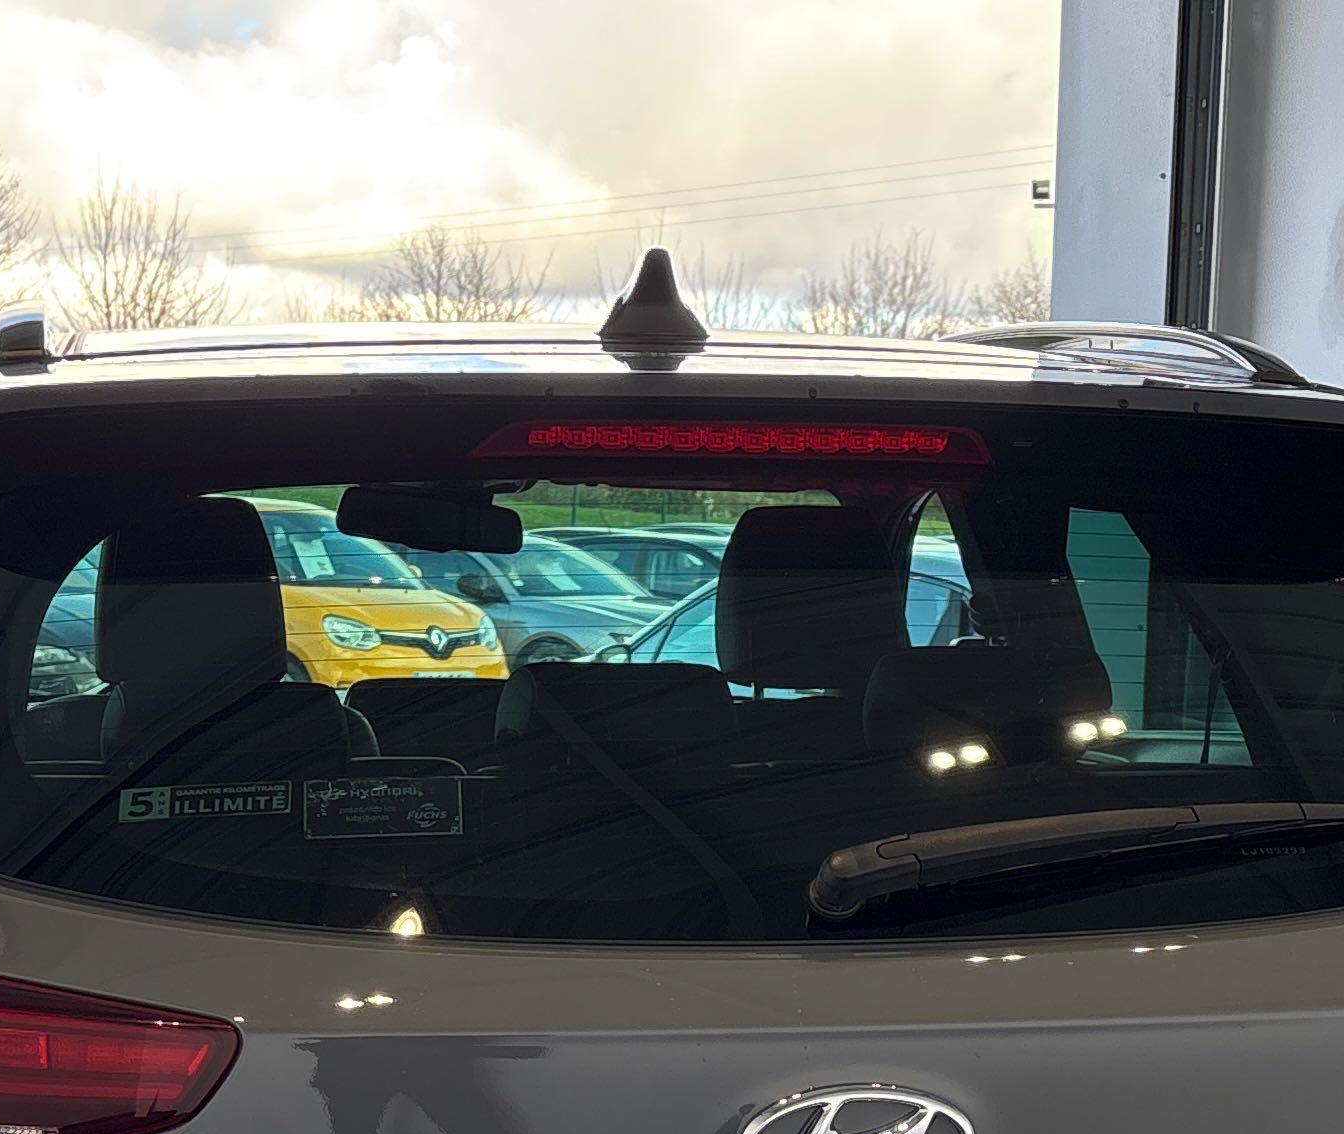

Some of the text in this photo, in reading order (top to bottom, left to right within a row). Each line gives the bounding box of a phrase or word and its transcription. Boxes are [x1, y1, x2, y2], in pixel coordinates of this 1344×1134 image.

[128, 792, 155, 817] 5
[174, 791, 286, 815] ILLIMITÉ
[406, 809, 449, 821] FUCHS
